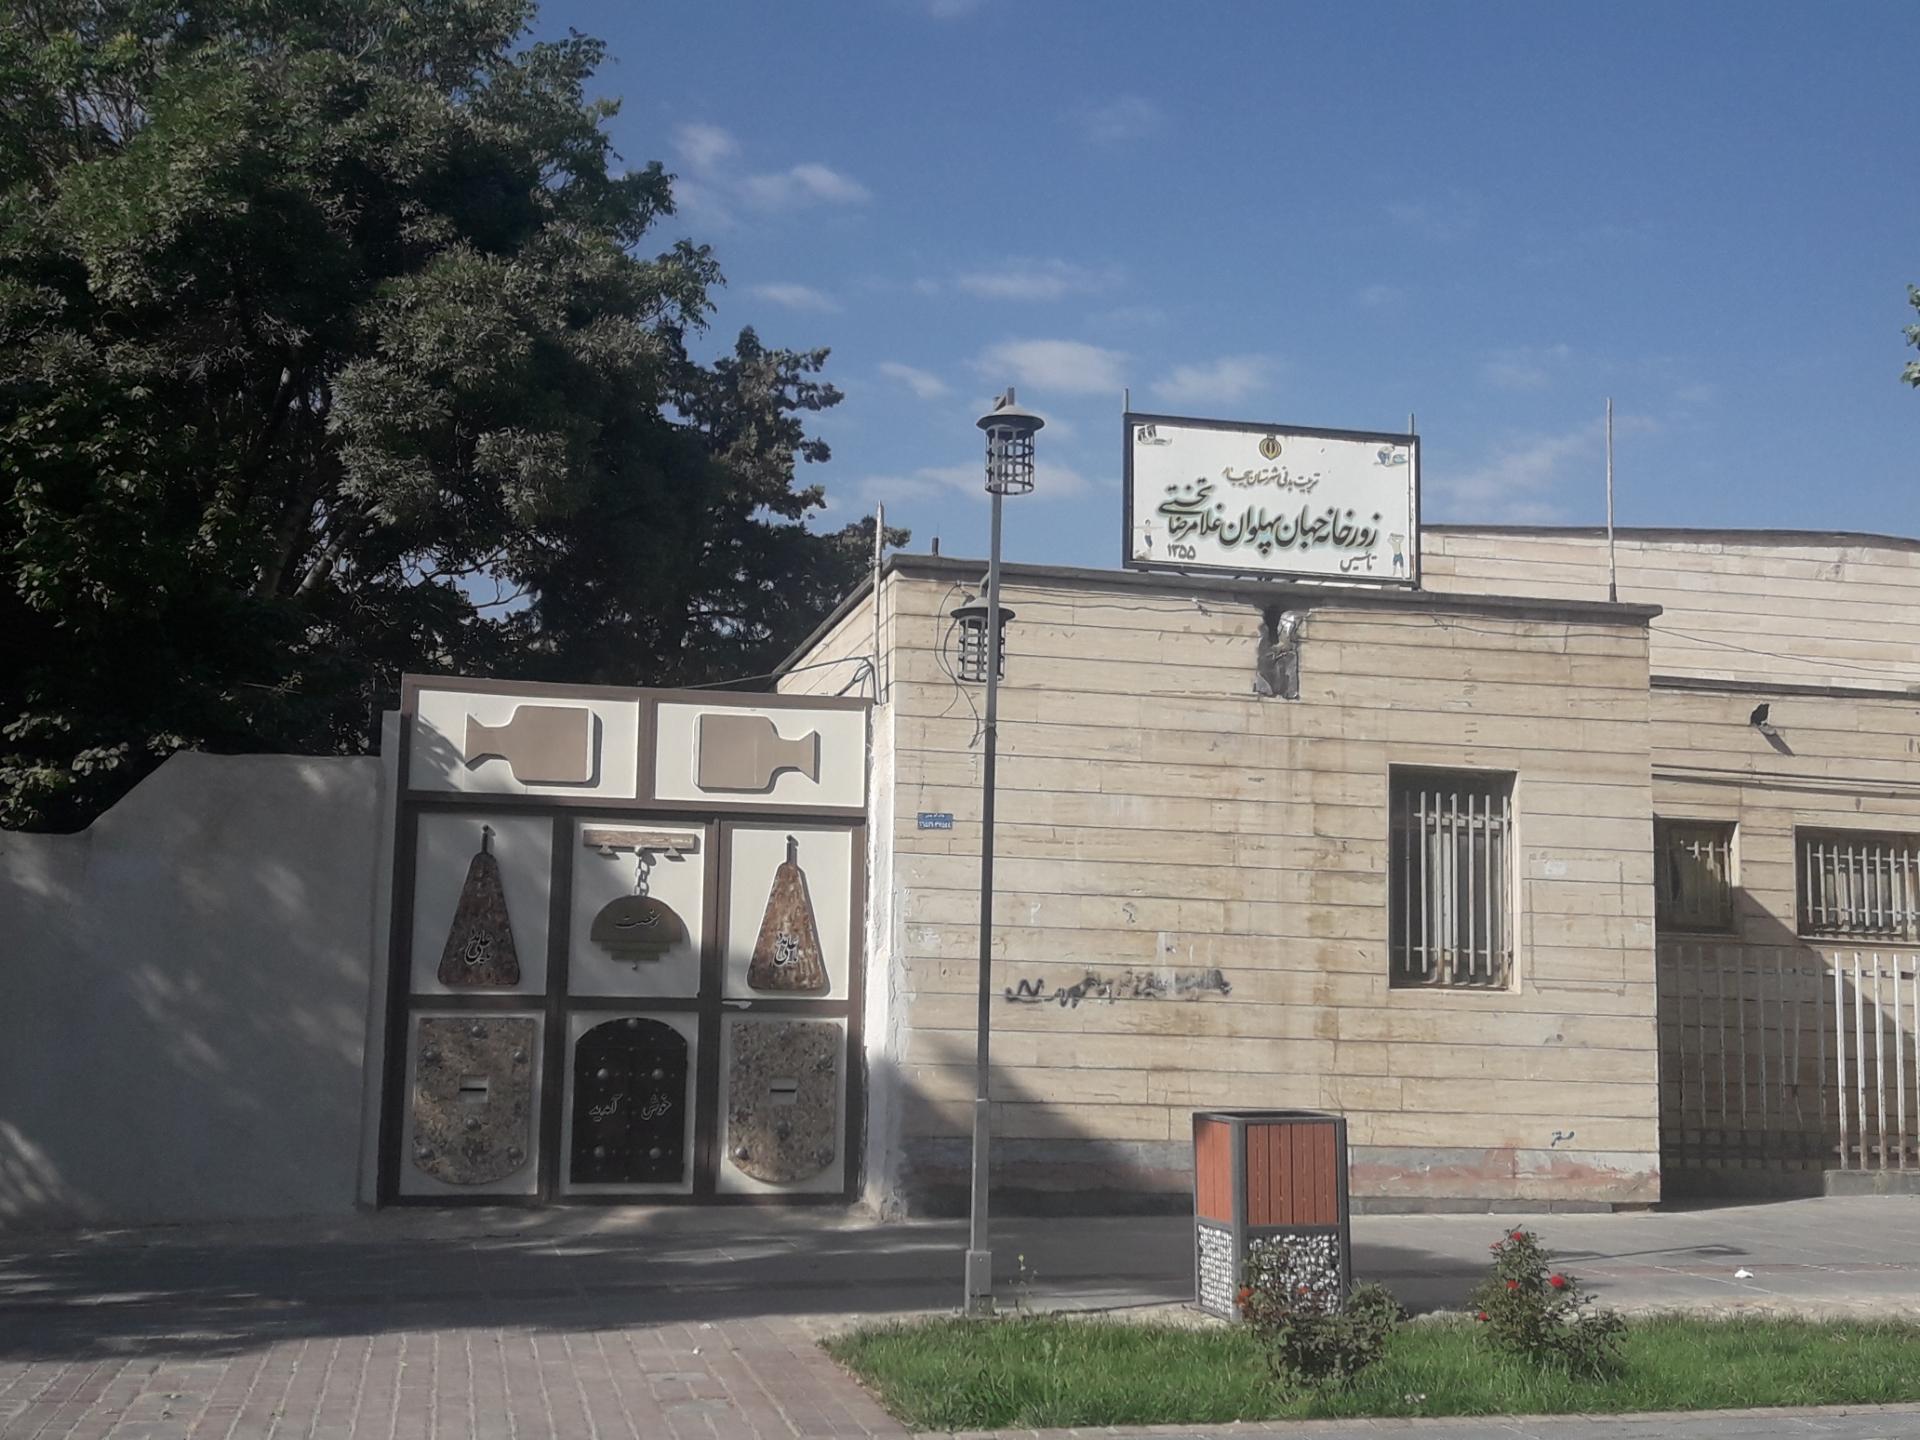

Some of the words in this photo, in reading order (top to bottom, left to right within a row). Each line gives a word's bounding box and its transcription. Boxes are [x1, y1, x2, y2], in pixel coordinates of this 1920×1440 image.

[1246, 465, 1281, 486] شهرستان
[1277, 465, 1293, 493] بدنی
[1293, 472, 1321, 494] تربیت
[1158, 477, 1214, 515] تختی
[1168, 503, 1223, 542] غلامرضا
[1219, 505, 1283, 555] پهلوان
[1275, 504, 1330, 550] جهان
[1312, 507, 1380, 548] زورخانه
[1167, 543, 1196, 559] ۱۳۵۵
[615, 908, 662, 928] رخصت
[588, 1094, 624, 1122] آمدید
[641, 1093, 672, 1120] خوش
